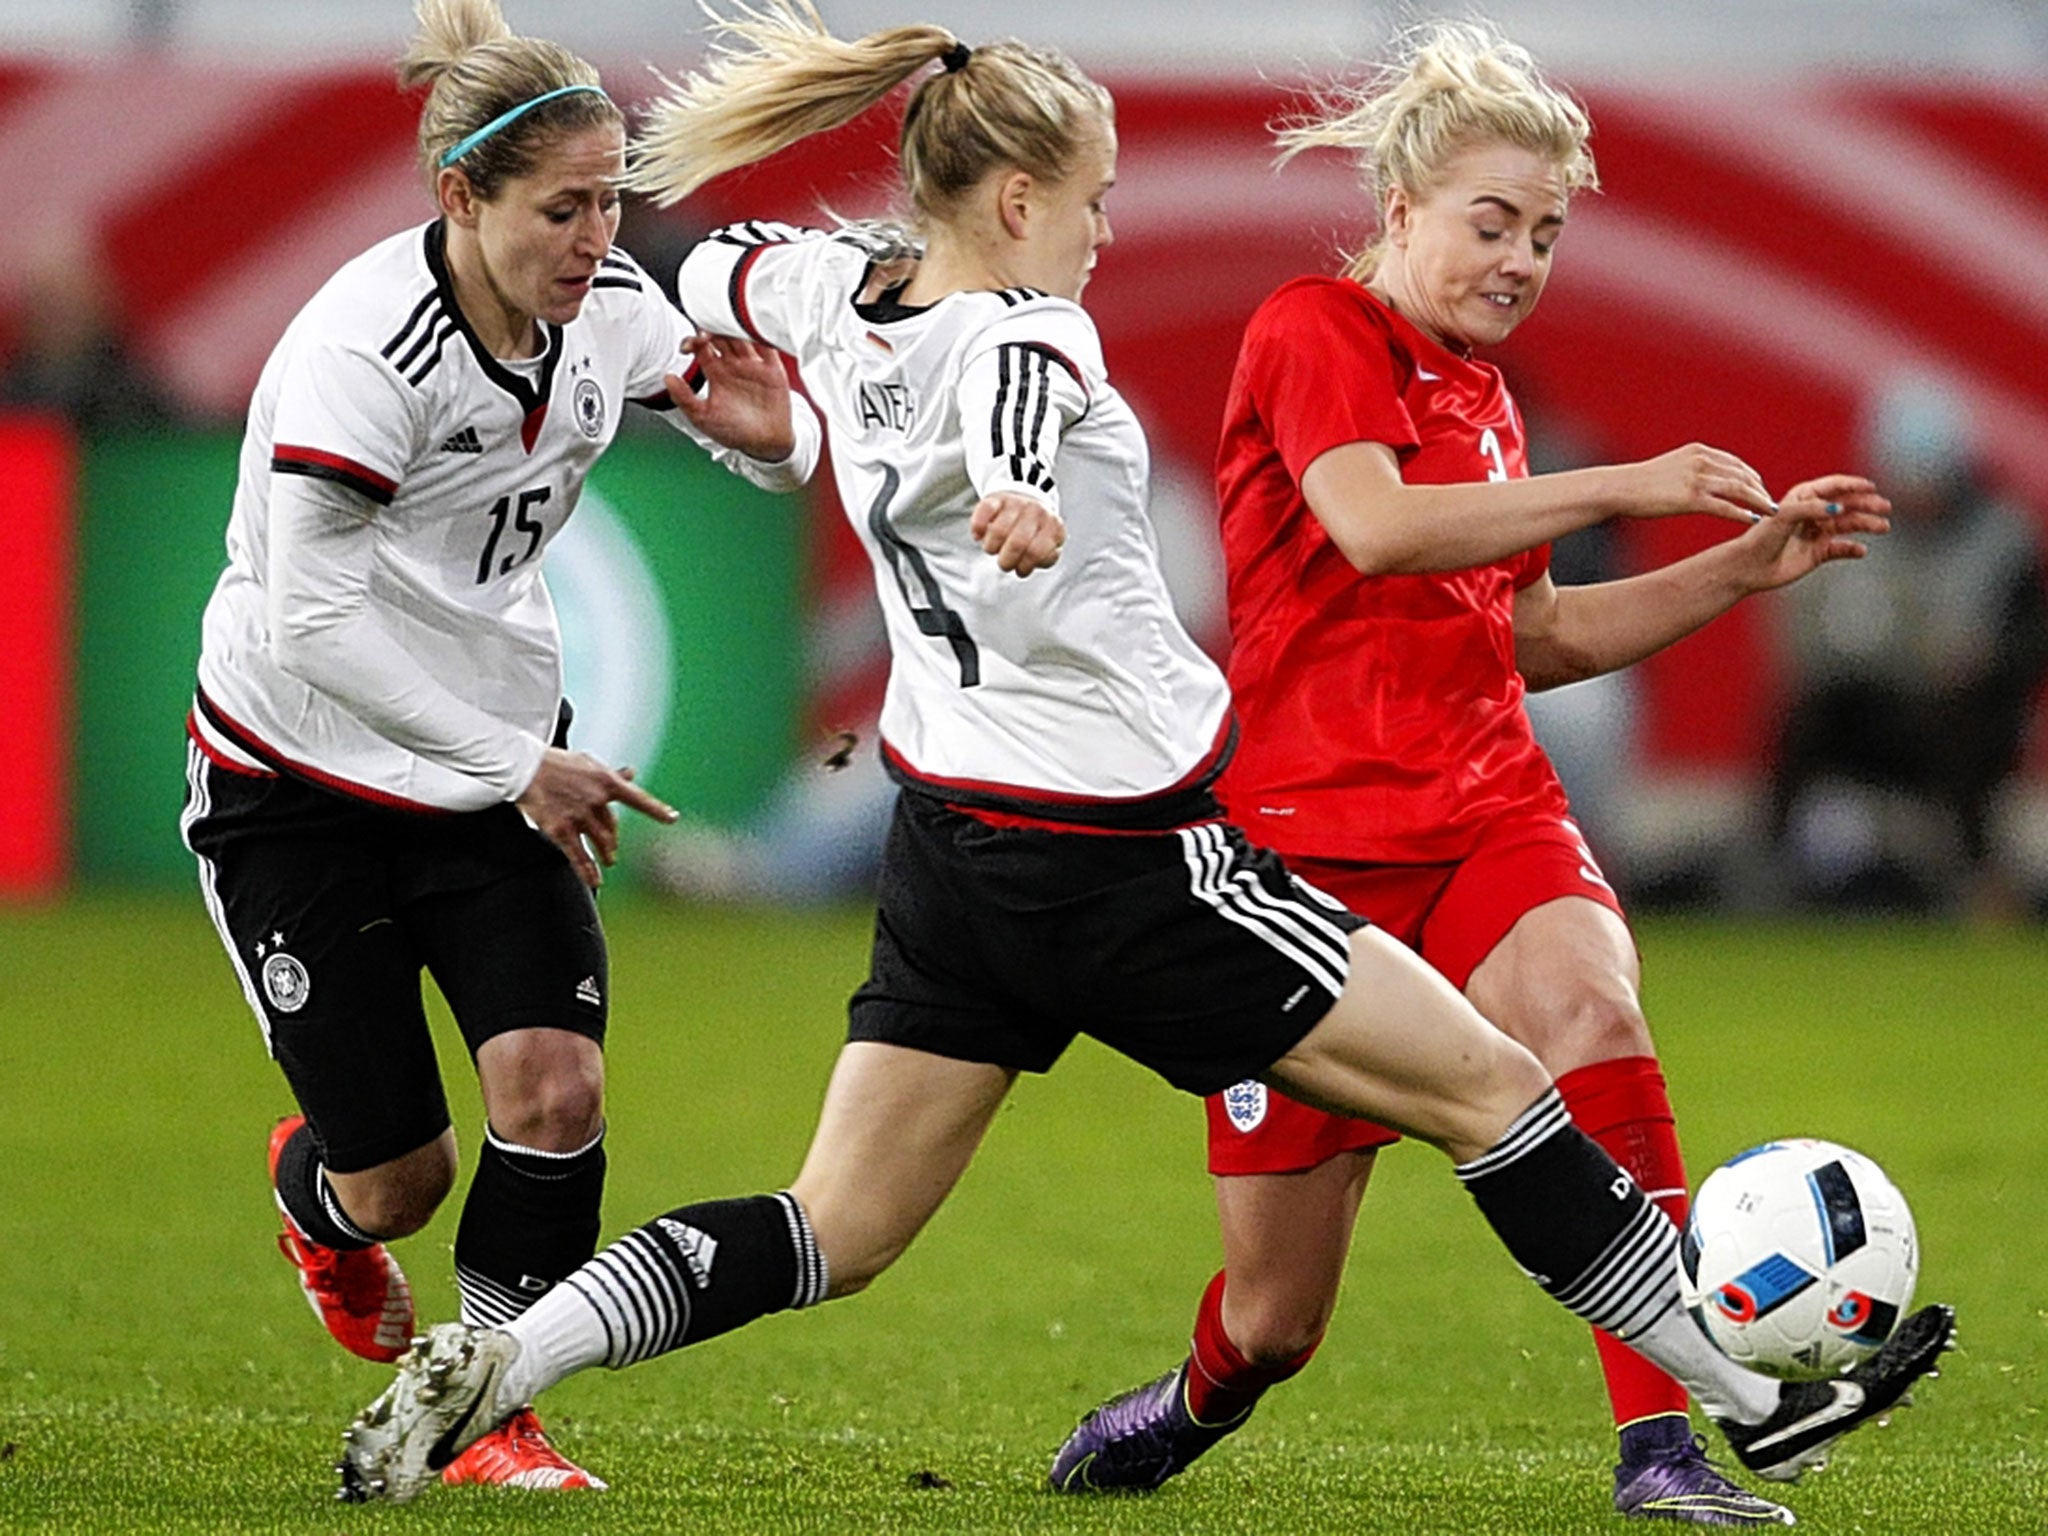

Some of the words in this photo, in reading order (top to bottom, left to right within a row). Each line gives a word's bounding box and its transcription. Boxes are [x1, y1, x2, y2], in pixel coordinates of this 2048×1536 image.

[1480, 428, 1508, 482] 3
[475, 485, 551, 585] 15
[868, 459, 980, 689] 4
